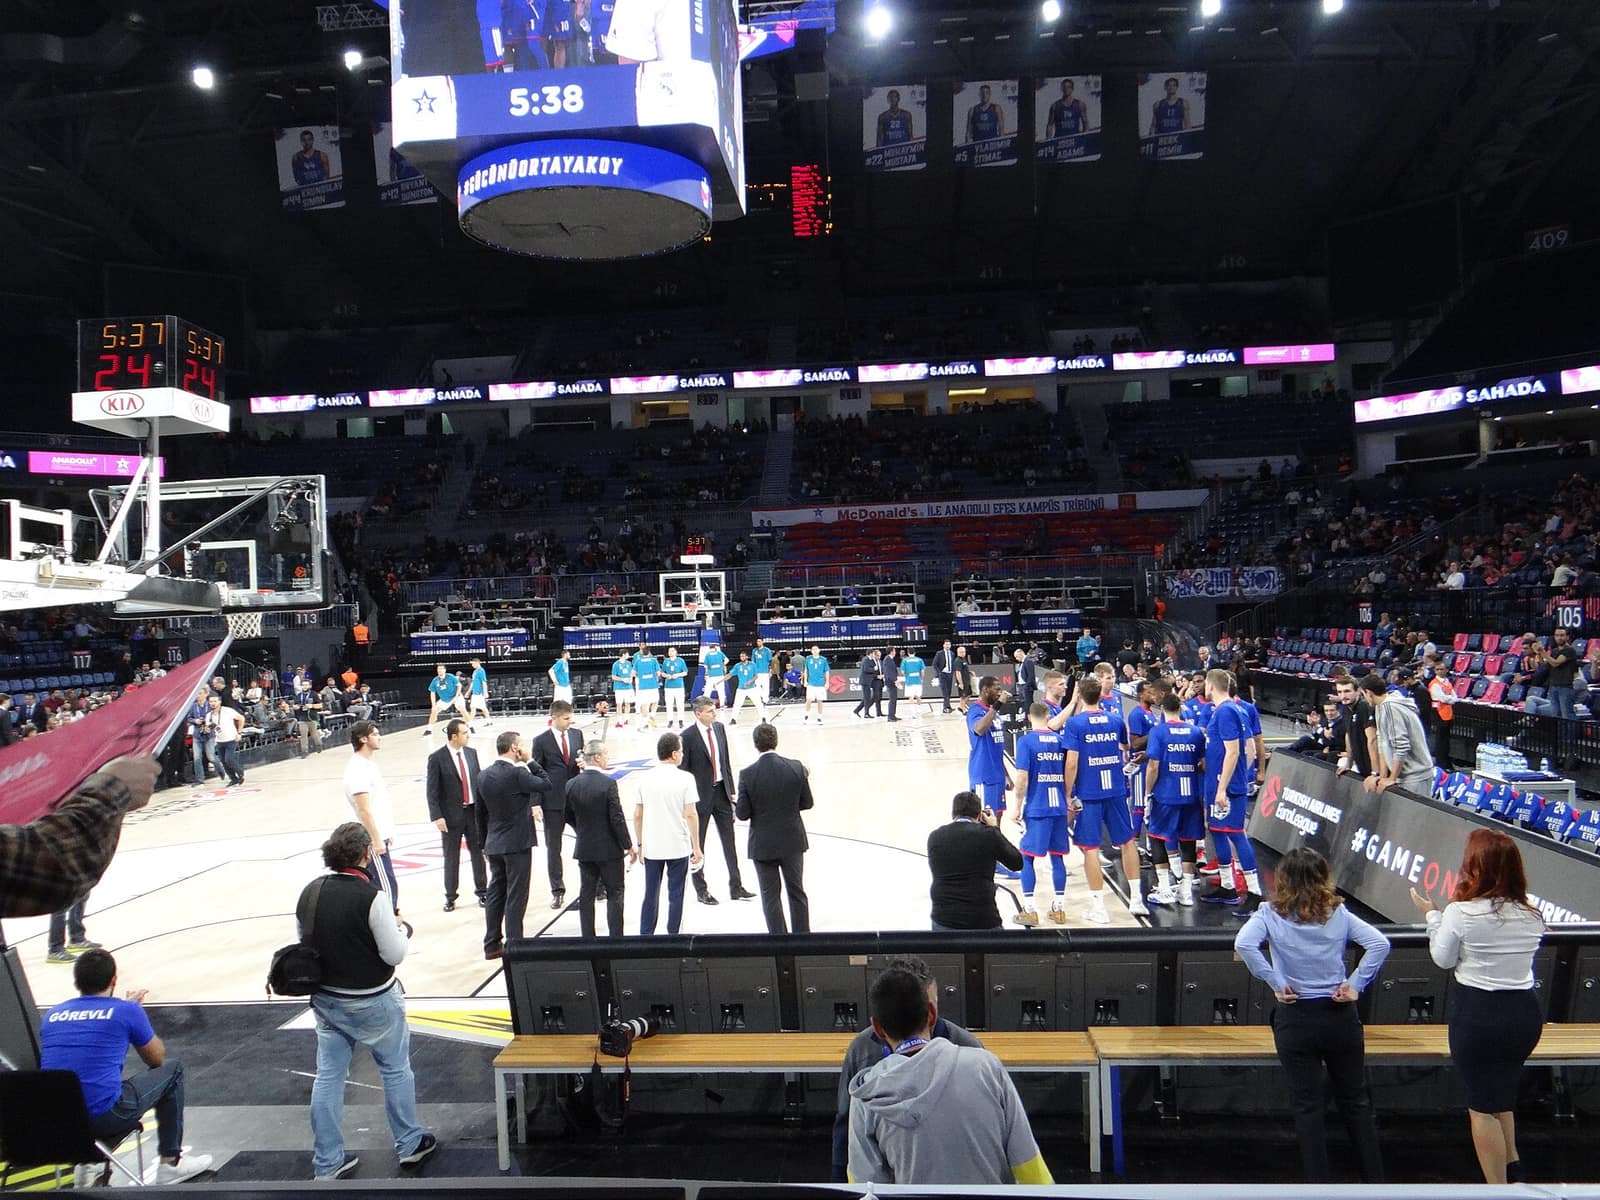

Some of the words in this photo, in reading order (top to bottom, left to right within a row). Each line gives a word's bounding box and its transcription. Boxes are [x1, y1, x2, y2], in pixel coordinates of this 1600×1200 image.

[509, 84, 584, 116] 5:38
[1529, 230, 1568, 250] 409
[103, 322, 165, 349] 5:37
[187, 330, 224, 365] 5:37
[1057, 357, 1105, 371] SAHADA
[1186, 352, 1236, 365] SAHADA
[94, 353, 151, 392] 24
[803, 370, 850, 382] SAHADA
[929, 364, 977, 376] SAHADA
[183, 359, 217, 400] 24
[679, 376, 726, 389] SAHADA
[437, 388, 482, 401] SAHADA
[557, 382, 603, 394] SAHADA
[1465, 380, 1546, 403] SAHADA
[107, 397, 137, 411] KIA
[317, 395, 362, 407] SAHADA
[194, 403, 211, 418] KIA
[837, 508, 918, 521] McDonald's
[944, 502, 991, 516] ANADOLU
[992, 502, 1016, 514] EFES
[1018, 499, 1061, 513] KAMPÜS
[296, 613, 317, 624] 113
[1359, 607, 1372, 623] 106
[1557, 606, 1582, 628] 105
[168, 618, 191, 629] 114
[905, 629, 926, 641] 111
[167, 650, 183, 662] 116
[489, 645, 511, 657] 112
[73, 655, 91, 669] 117
[1085, 732, 1118, 743] SARAR
[1524, 792, 1534, 805] 12
[1553, 801, 1566, 815] 24
[1589, 809, 1600, 824] 14
[49, 1007, 115, 1023] GÖREVLİ
